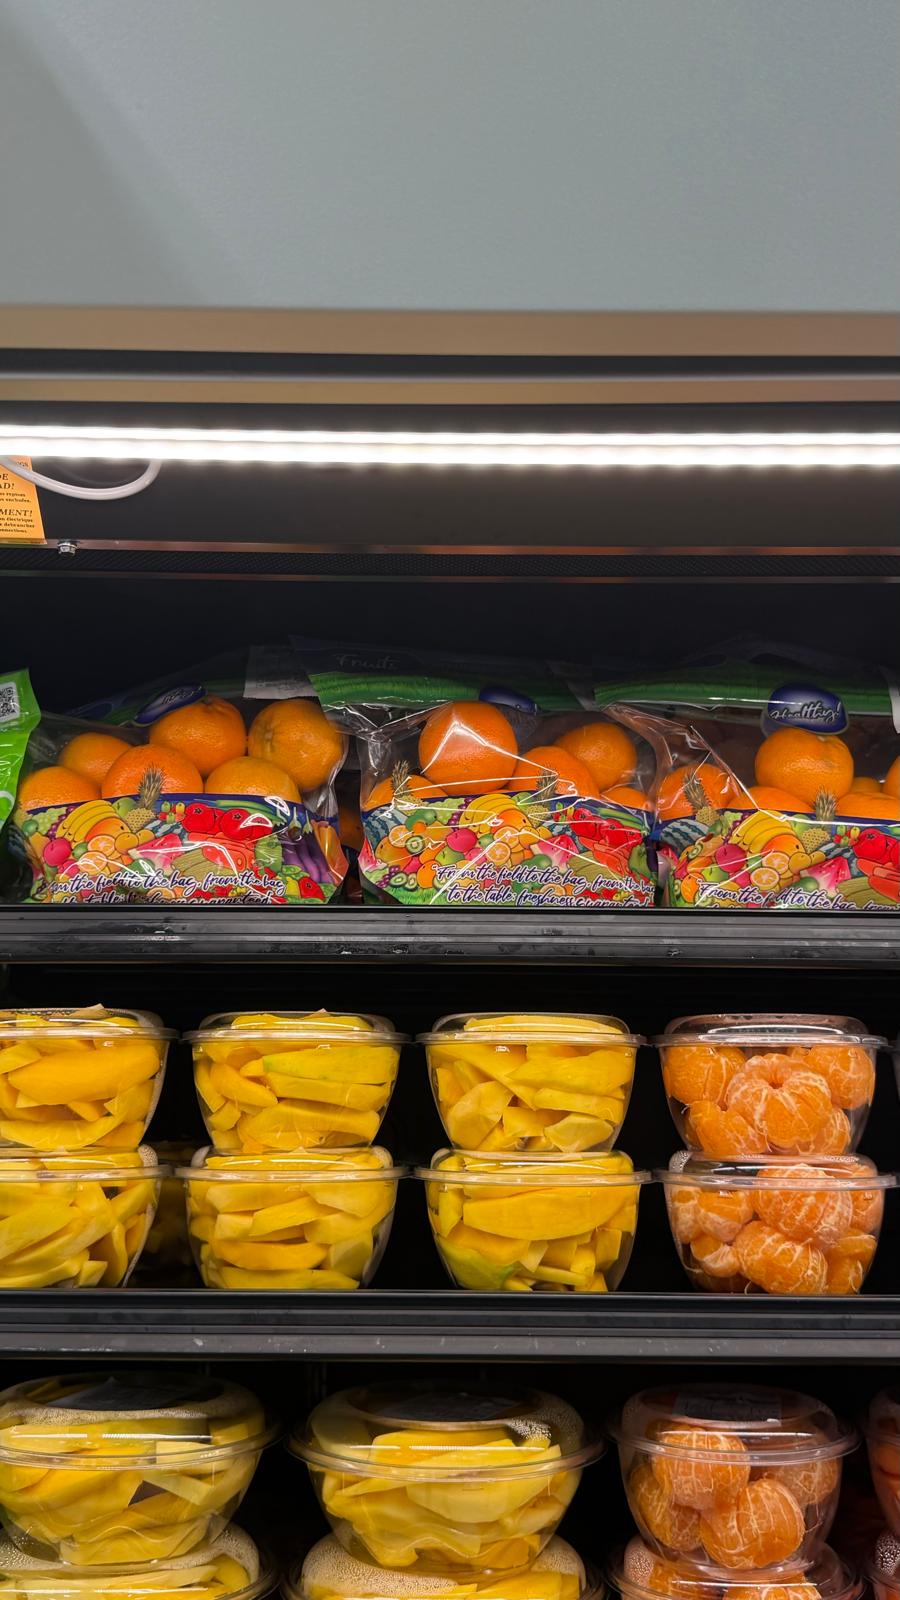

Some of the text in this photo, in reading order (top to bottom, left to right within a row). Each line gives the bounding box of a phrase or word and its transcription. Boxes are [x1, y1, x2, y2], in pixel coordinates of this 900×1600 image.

[71, 872, 94, 891] the
[203, 874, 238, 890] from
[477, 864, 497, 879] the
[497, 866, 523, 884] field
[525, 867, 539, 882] to
[540, 868, 561, 884] the
[592, 876, 622, 891] from
[448, 886, 460, 902] to
[463, 885, 484, 902] the
[738, 885, 762, 903] the
[806, 889, 830, 907] the
